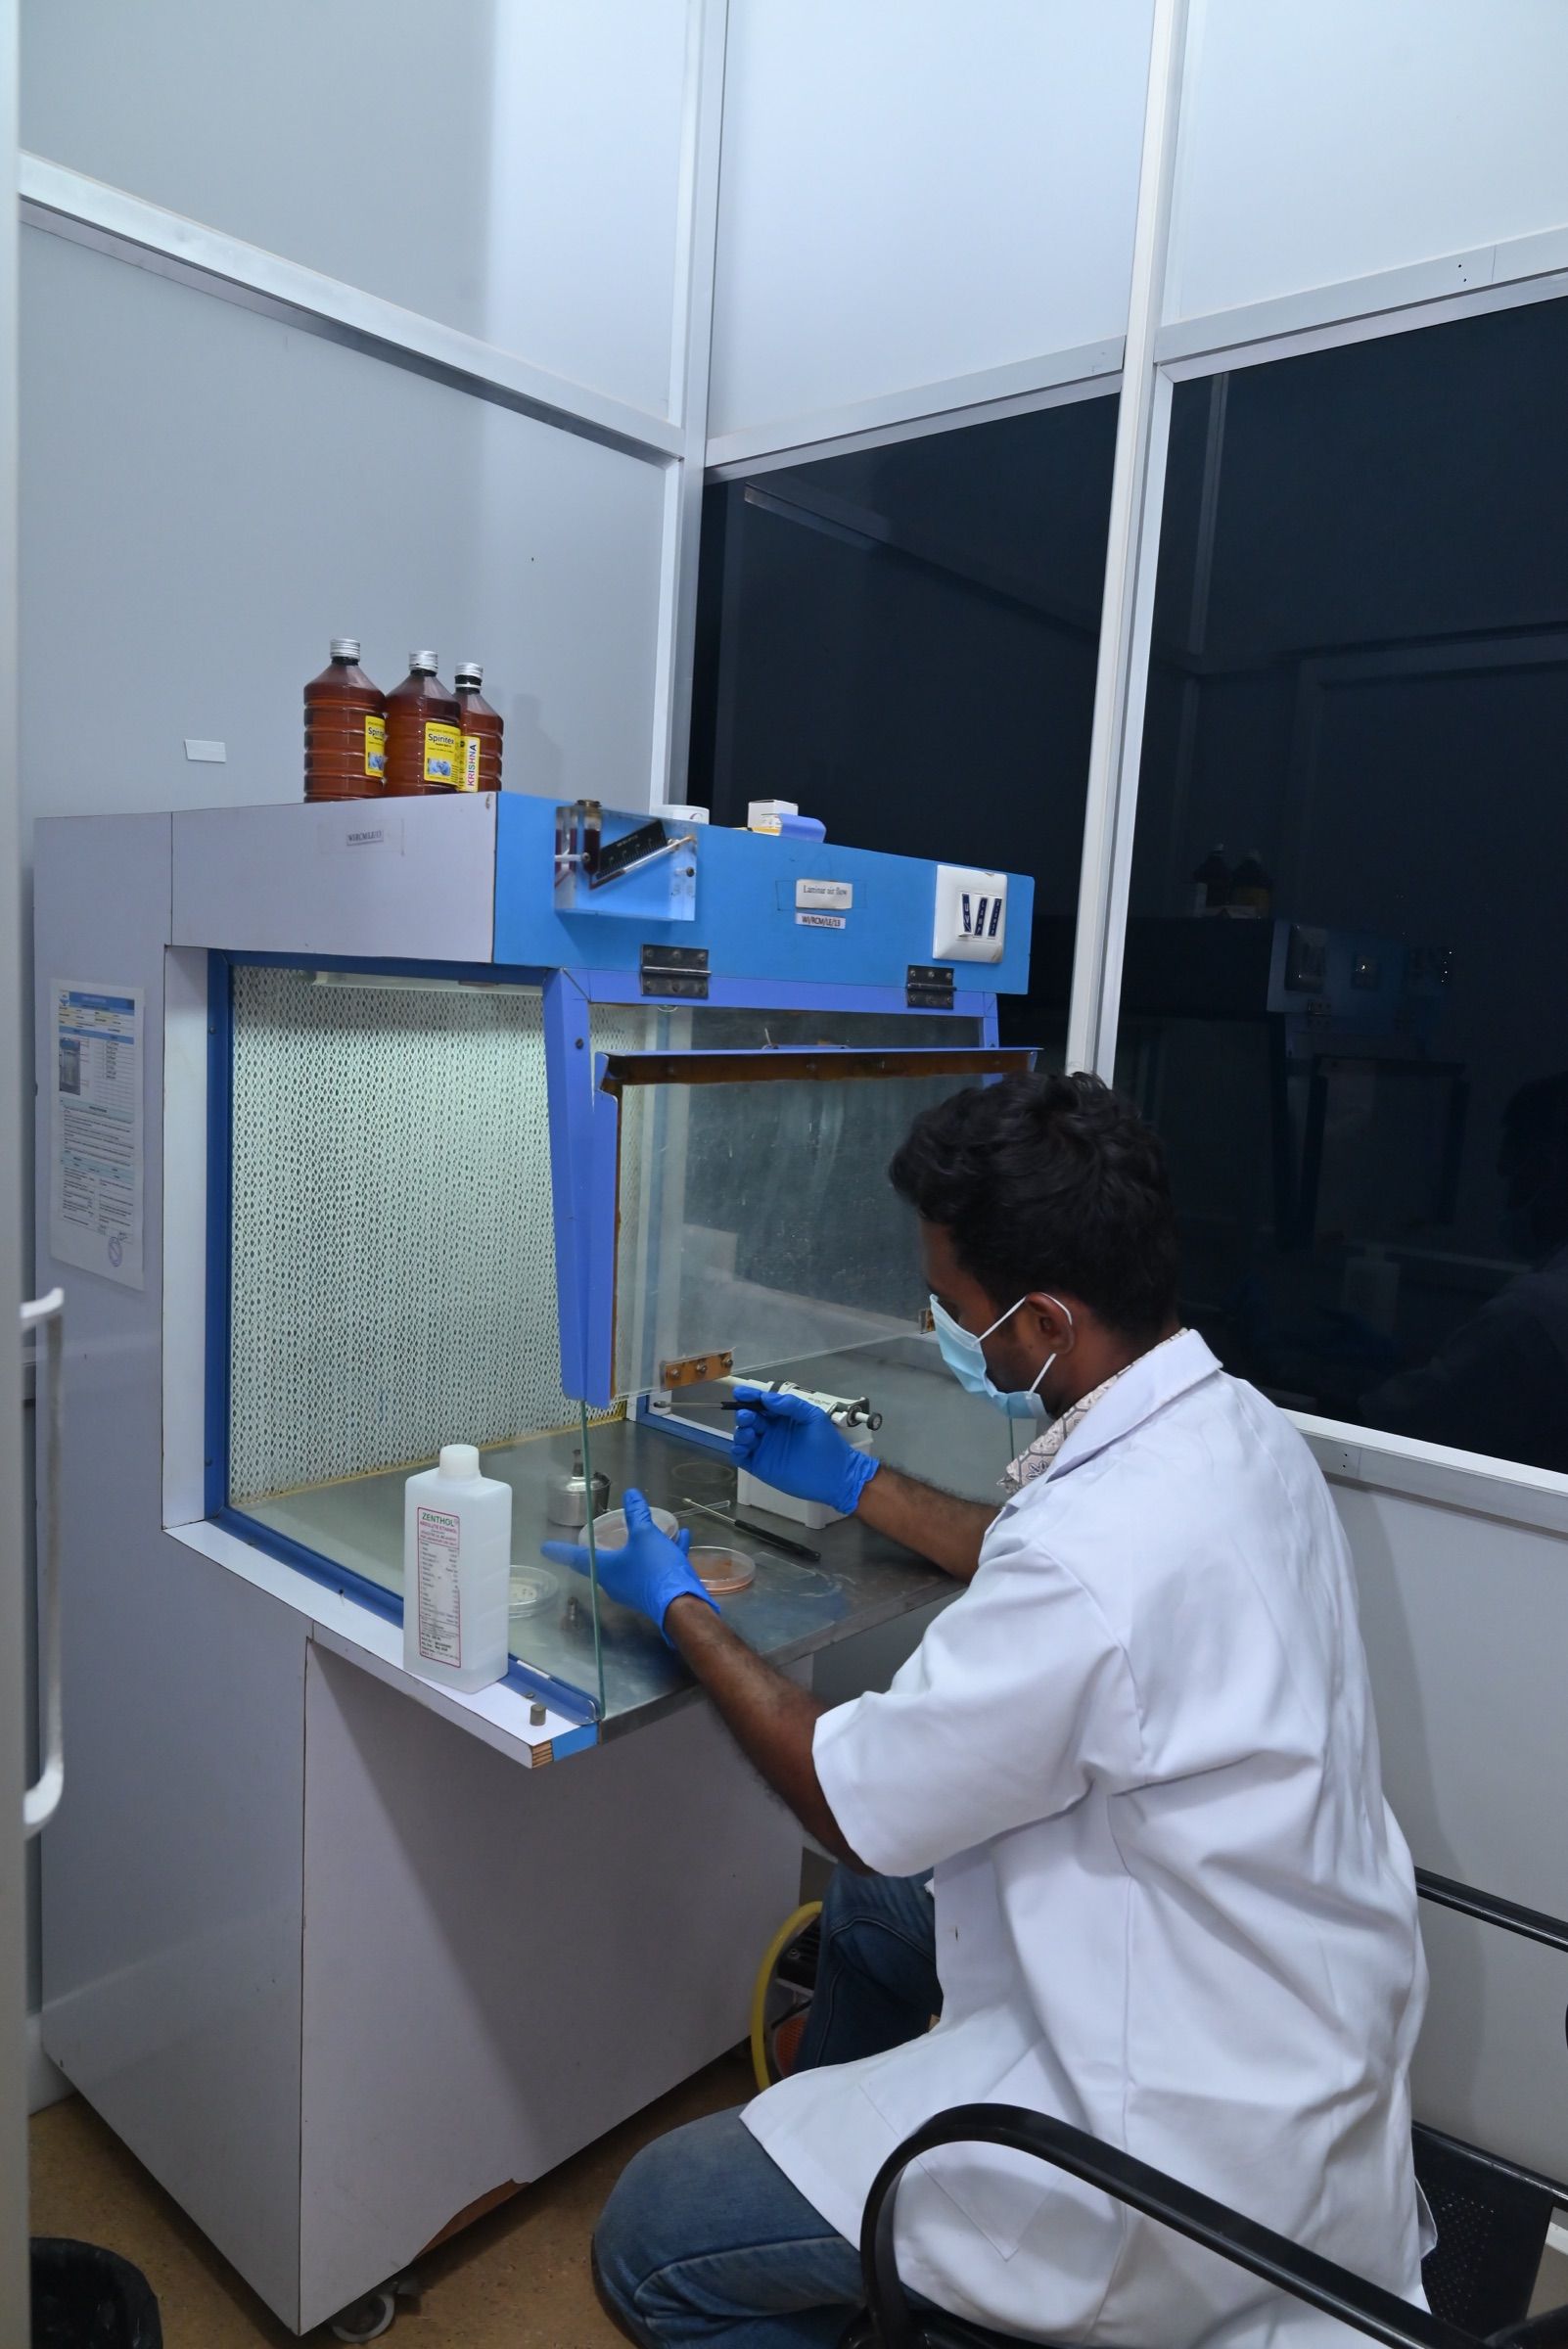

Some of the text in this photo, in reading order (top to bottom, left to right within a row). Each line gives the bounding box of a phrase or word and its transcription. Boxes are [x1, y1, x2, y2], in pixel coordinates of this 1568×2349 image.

[428, 733, 455, 745] Spiritex
[467, 744, 478, 787] KRISHNA
[803, 885, 826, 895] Laminar
[836, 887, 848, 896] flow
[422, 1512, 454, 1527] ZENTHOL
